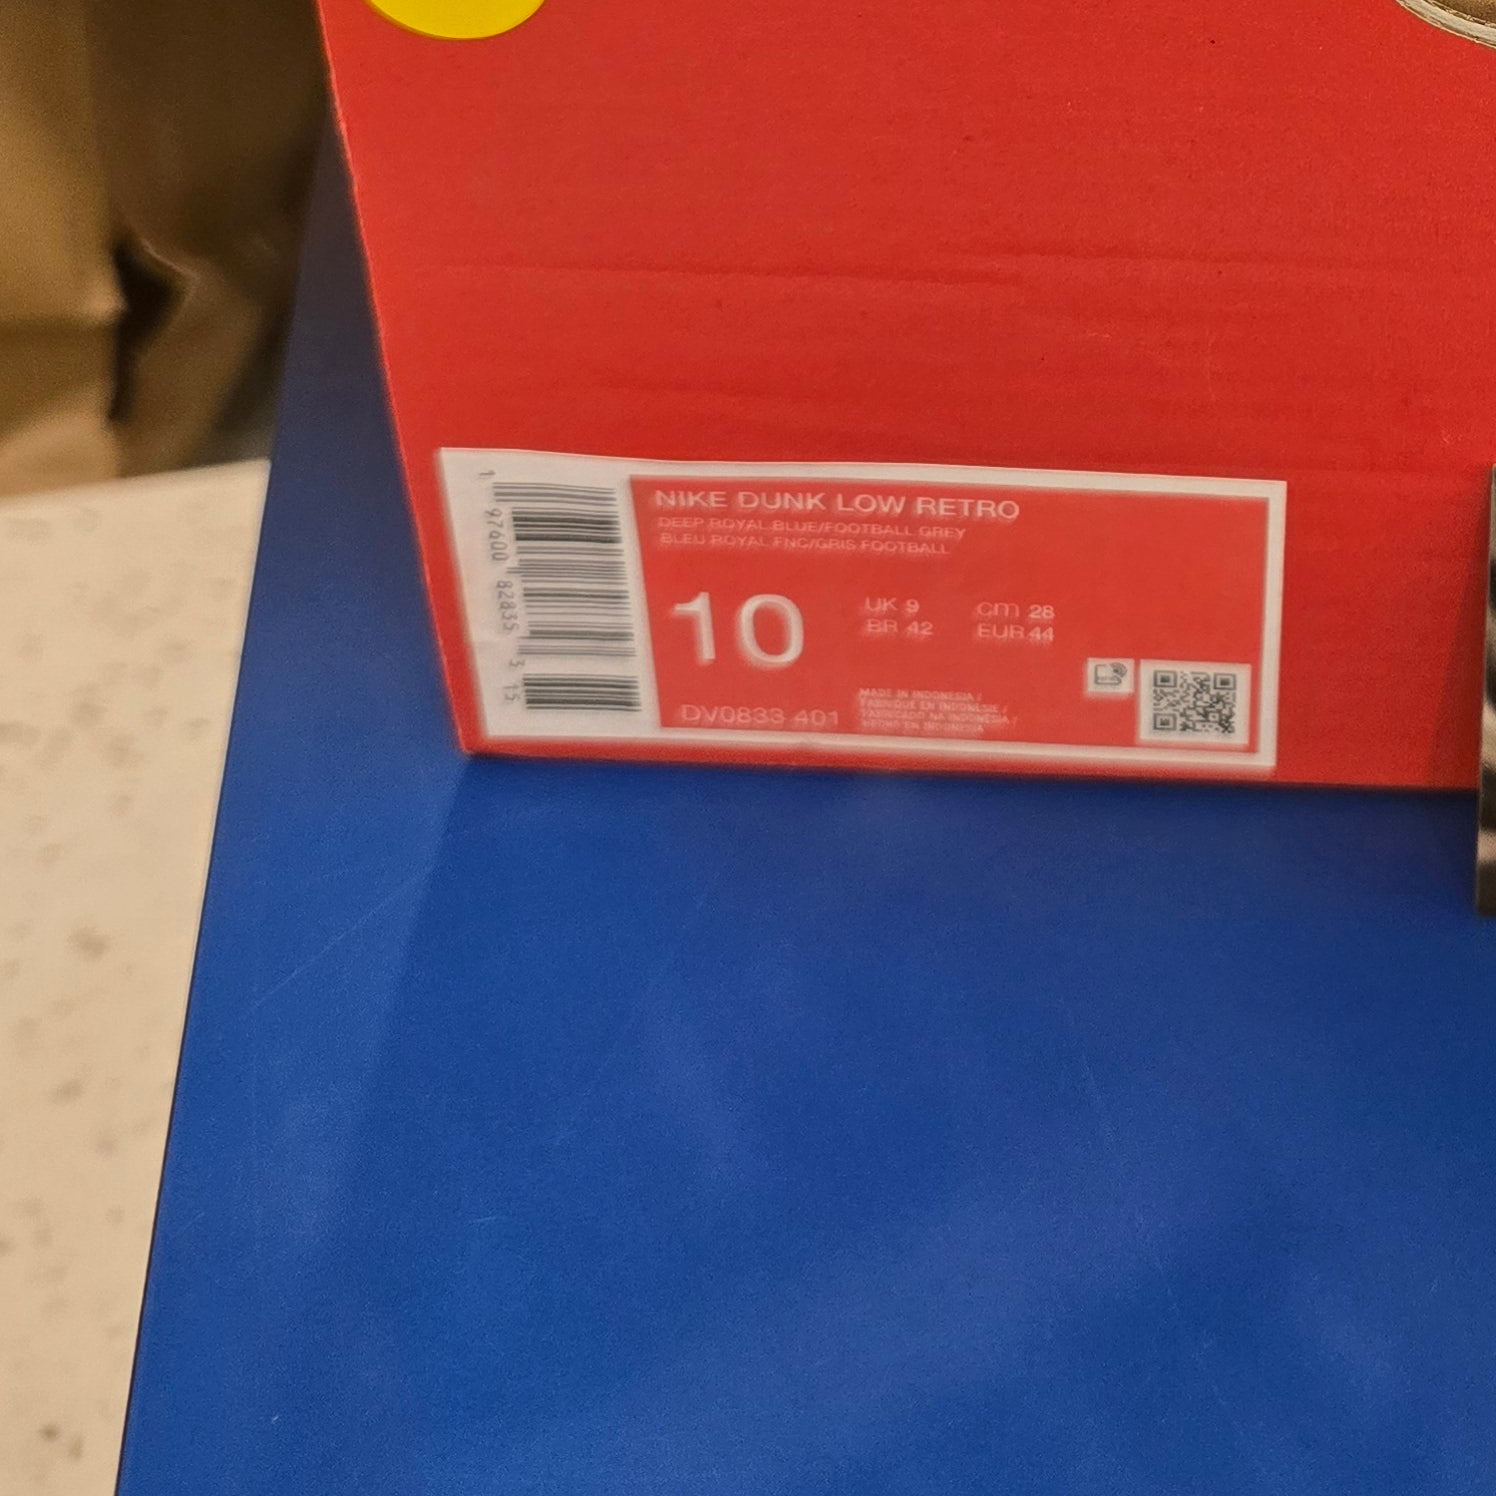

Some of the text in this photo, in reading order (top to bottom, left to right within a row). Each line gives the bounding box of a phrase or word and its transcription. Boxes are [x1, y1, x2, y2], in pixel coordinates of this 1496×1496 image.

[655, 490, 1020, 520] NIKE DUNK LOW RETRO
[485, 507, 509, 562] 97600
[657, 516, 967, 540] DEEP ROYAL BLUE/FOOTBALL GREY
[660, 533, 706, 546] BLEU
[710, 534, 768, 548] ROYAL
[861, 540, 950, 555] FOOTBALL
[864, 596, 920, 615] UK 9
[1028, 603, 1055, 620] 28
[671, 591, 804, 667] 10
[865, 619, 934, 637] BR 42
[977, 623, 1054, 642] EUR 44
[859, 687, 893, 698] MADE
[681, 704, 785, 725] DV0833
